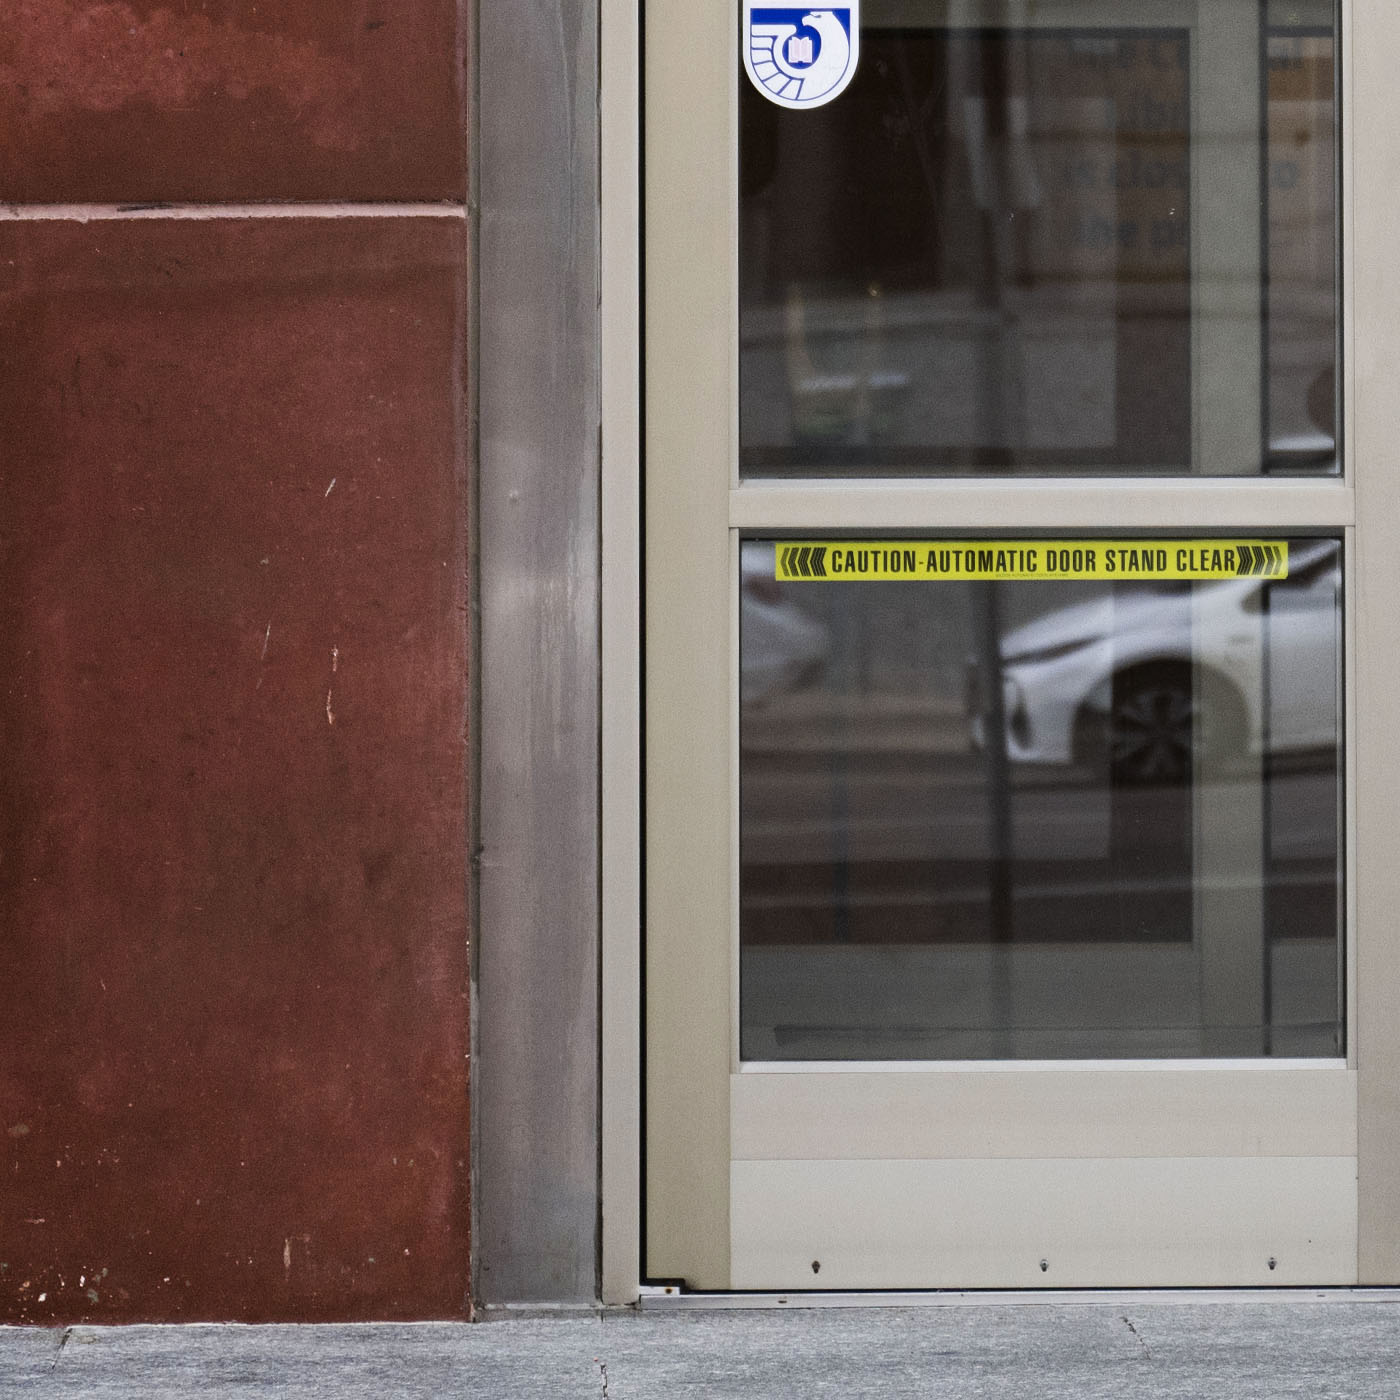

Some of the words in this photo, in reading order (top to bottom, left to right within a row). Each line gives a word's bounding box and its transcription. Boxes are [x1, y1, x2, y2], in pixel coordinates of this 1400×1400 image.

[1046, 548, 1096, 573] DOOR
[1105, 548, 1167, 573] STAND
[1176, 547, 1236, 572] CLEAR
